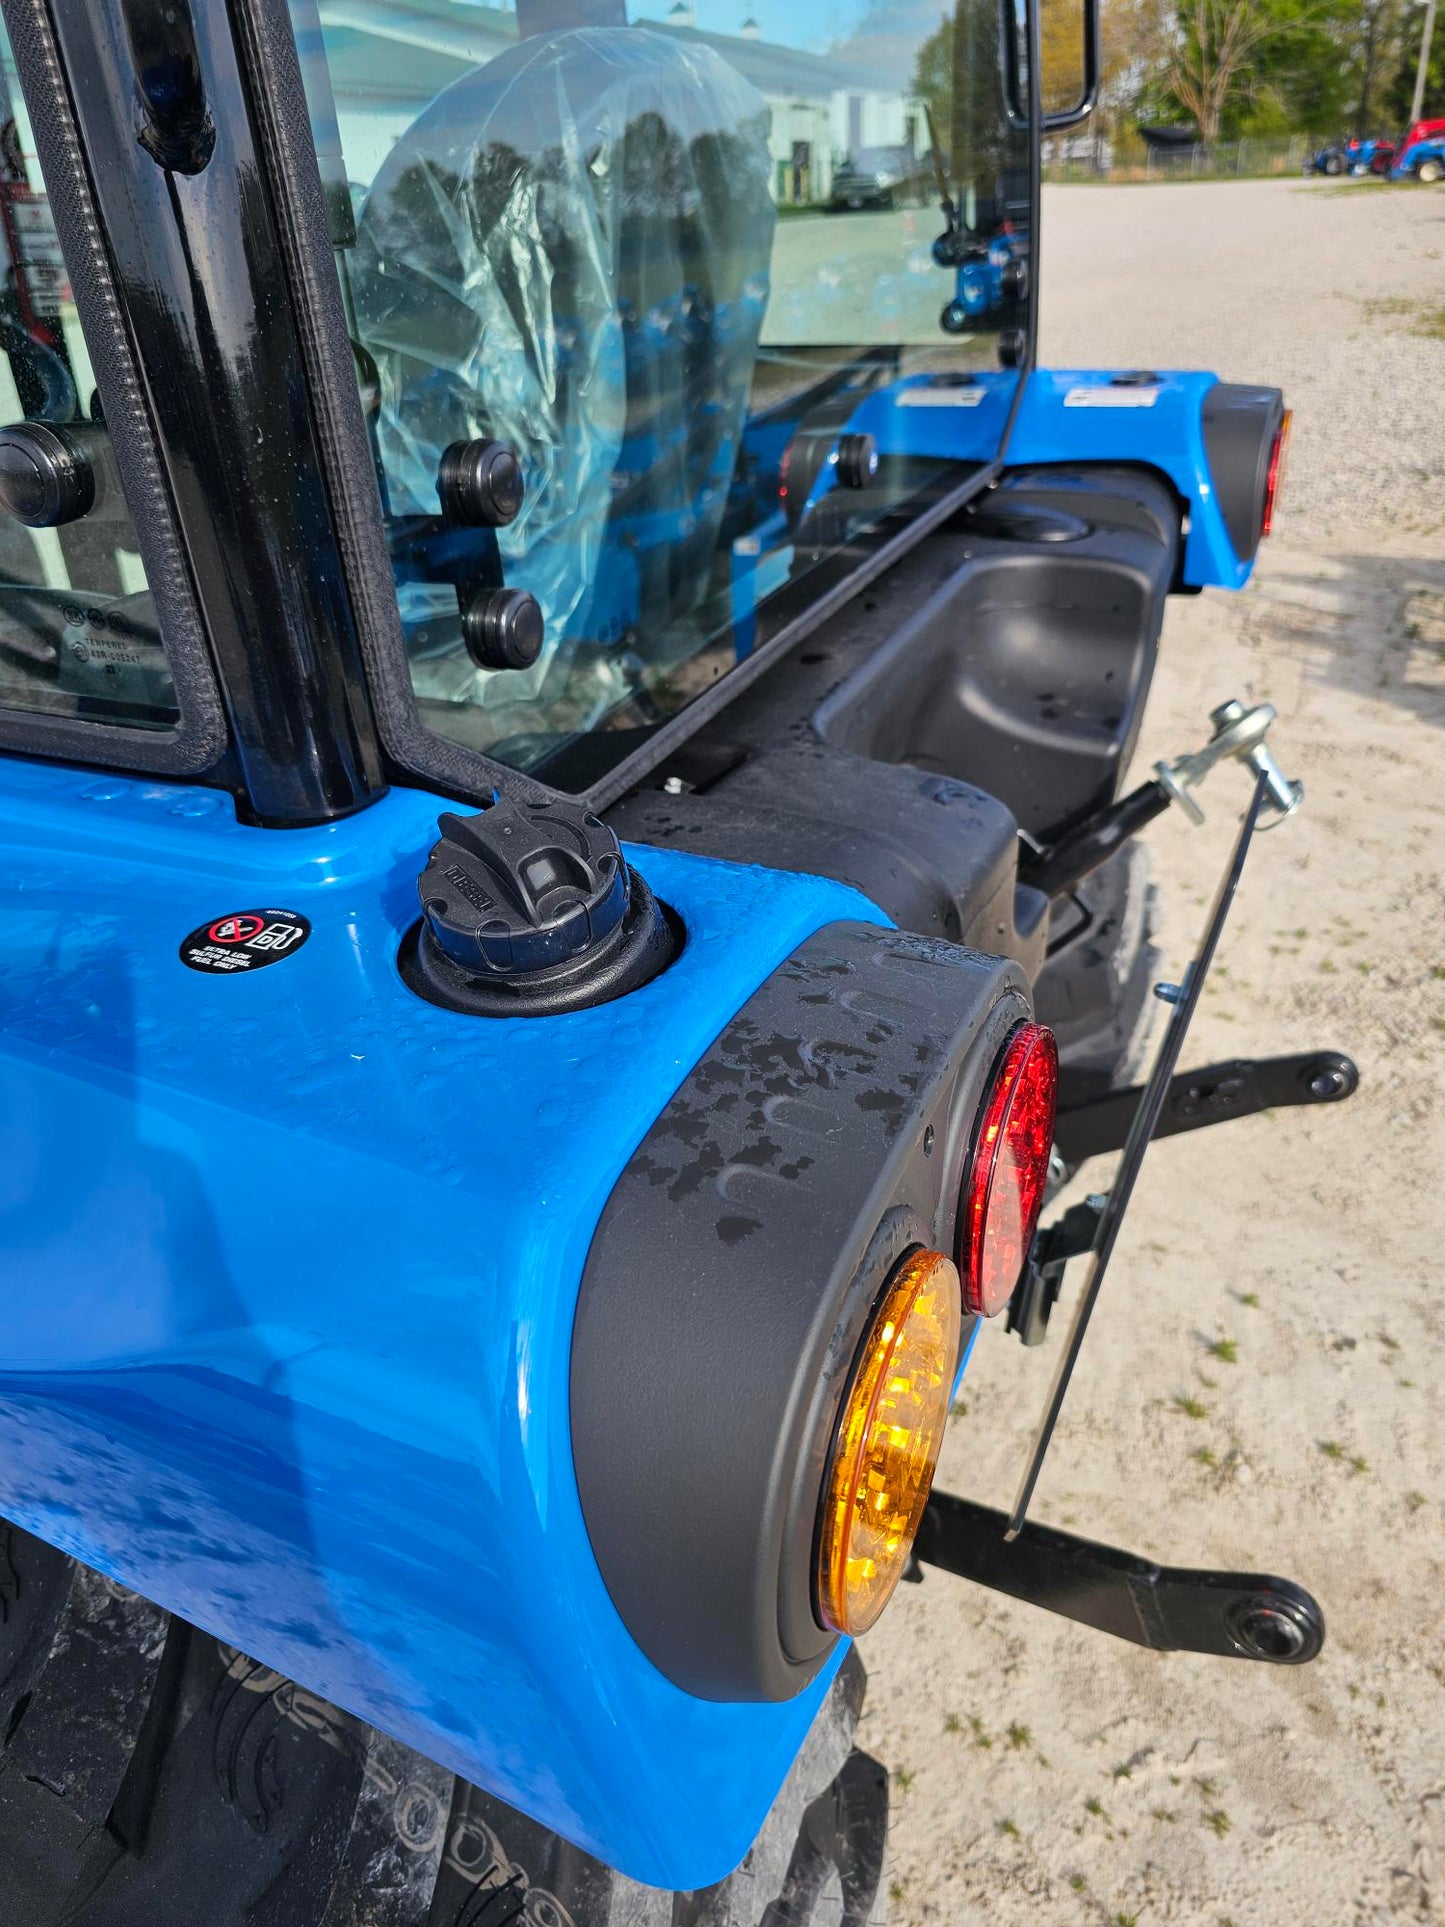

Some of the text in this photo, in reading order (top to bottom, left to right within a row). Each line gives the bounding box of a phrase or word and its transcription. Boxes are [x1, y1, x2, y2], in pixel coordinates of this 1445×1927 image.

[446, 868, 493, 912] DIESEL
[188, 948, 251, 968] SULFUR DIESEL
[203, 945, 253, 960] ULTRA LOW
[190, 956, 238, 970] FUEL ONLY
